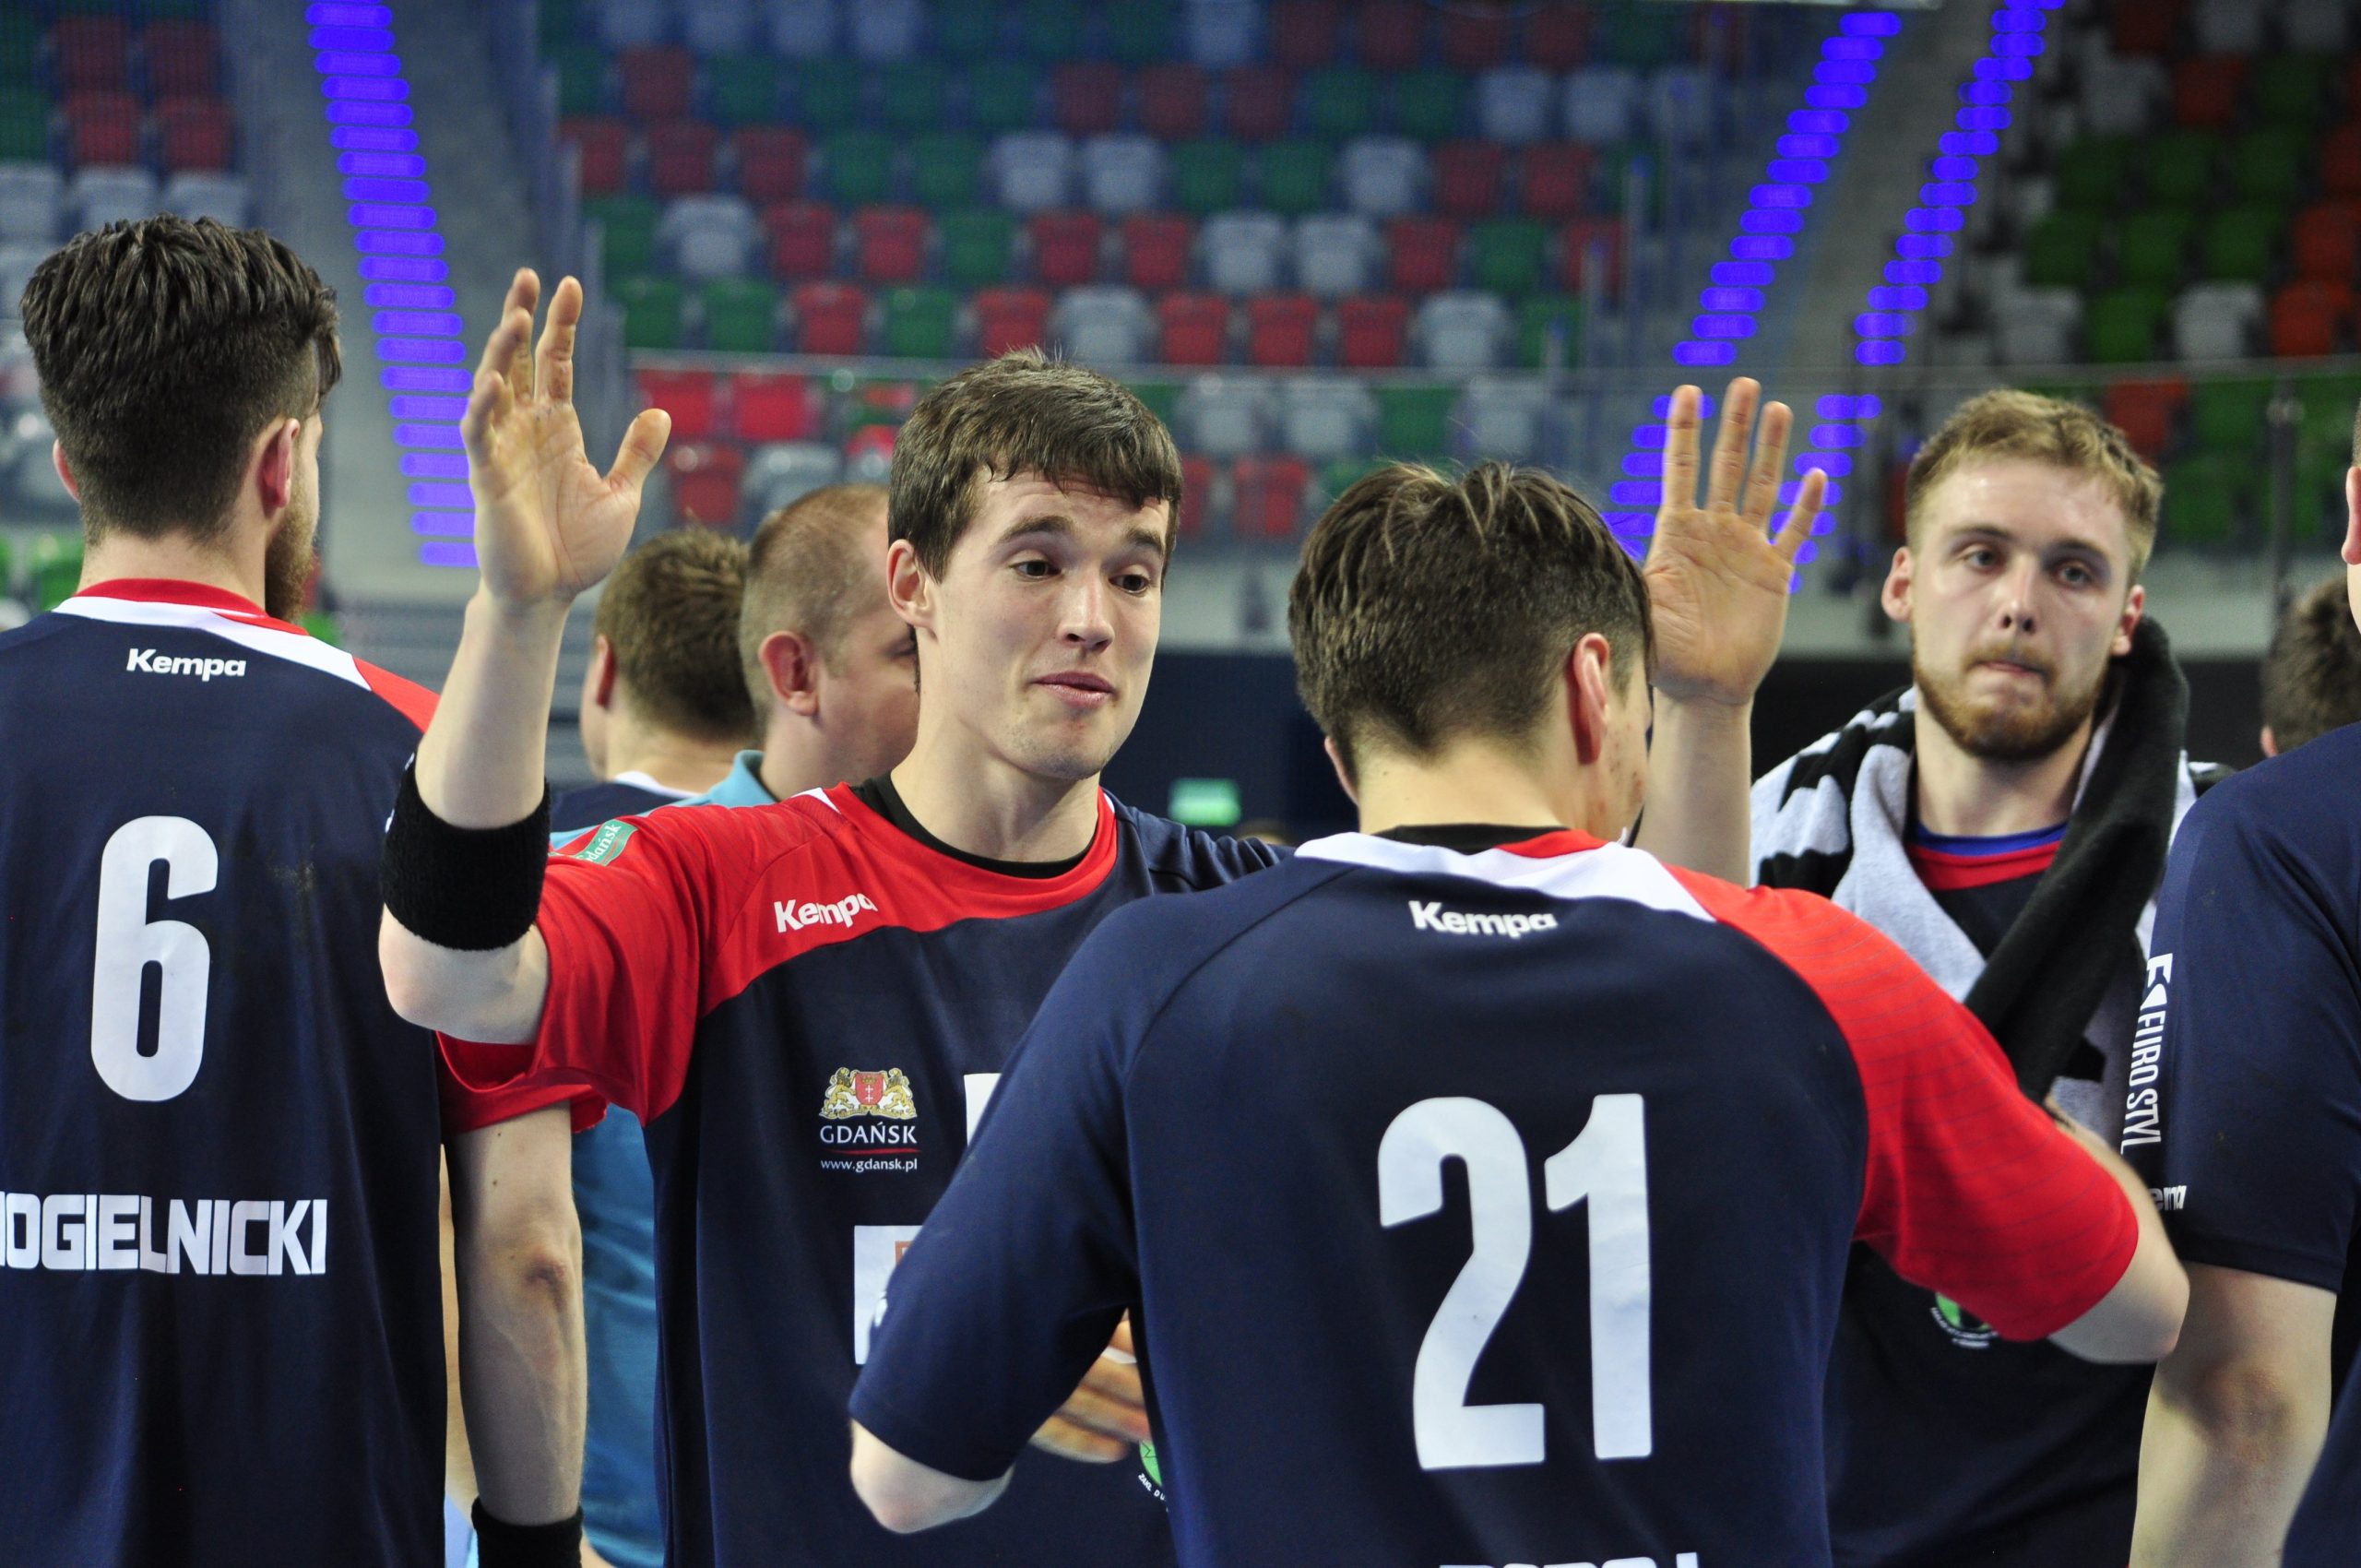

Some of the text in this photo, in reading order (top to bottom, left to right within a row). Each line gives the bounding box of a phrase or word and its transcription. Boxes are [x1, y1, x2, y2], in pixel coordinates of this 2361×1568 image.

[126, 648, 247, 683] Kempa
[575, 824, 623, 863] dańsk
[774, 893, 878, 933] Kempa
[1408, 900, 1559, 939] Kempa
[90, 815, 219, 1102] 6
[820, 1121, 918, 1144] GDAŃSK
[2120, 1087, 2162, 1155] STYL
[820, 1158, 918, 1173] www.gdansk.pl
[1377, 1093, 1652, 1470] 21
